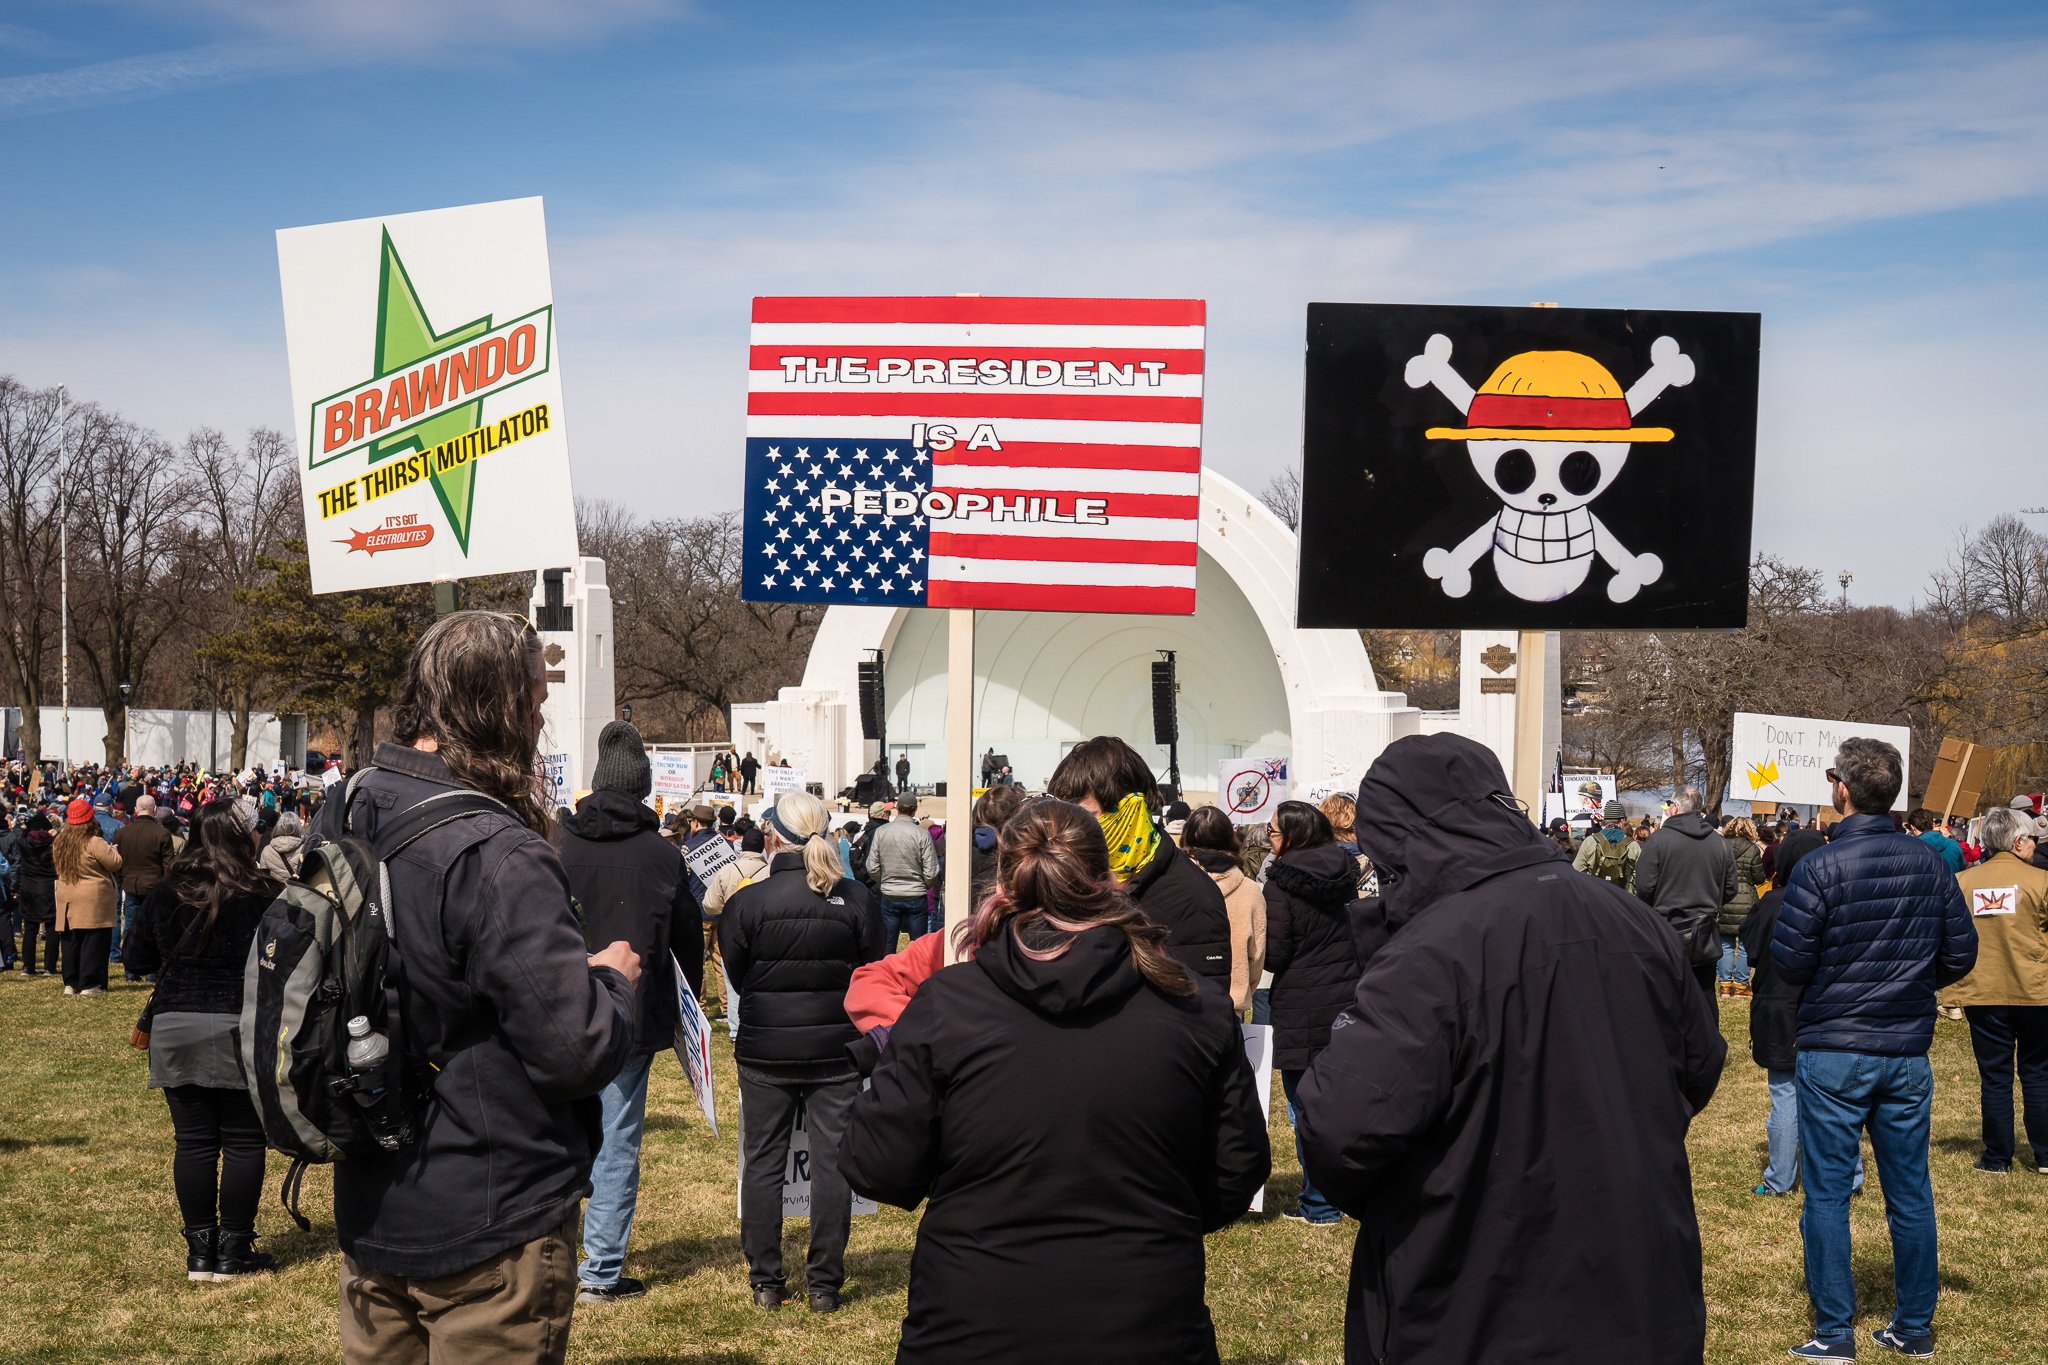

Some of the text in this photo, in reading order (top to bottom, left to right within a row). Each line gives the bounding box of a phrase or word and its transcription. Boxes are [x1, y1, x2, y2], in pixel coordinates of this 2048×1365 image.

[780, 356, 1168, 387] THE PRESIDENT
[324, 324, 536, 453] BRAWNDO
[911, 423, 1002, 451] IS A
[318, 405, 549, 519] THE THIRST MUTILATOR
[820, 488, 1109, 525] PEDOPHILE
[385, 514, 418, 528] IT'S GOT
[366, 529, 427, 547] ELECTROLYTES
[1818, 730, 1845, 748] MAK
[1778, 749, 1824, 768] REPEAT
[1310, 787, 1332, 800] ACT
[686, 837, 724, 864] MORONS
[703, 851, 721, 866] ARE
[699, 854, 737, 880] RUINING
